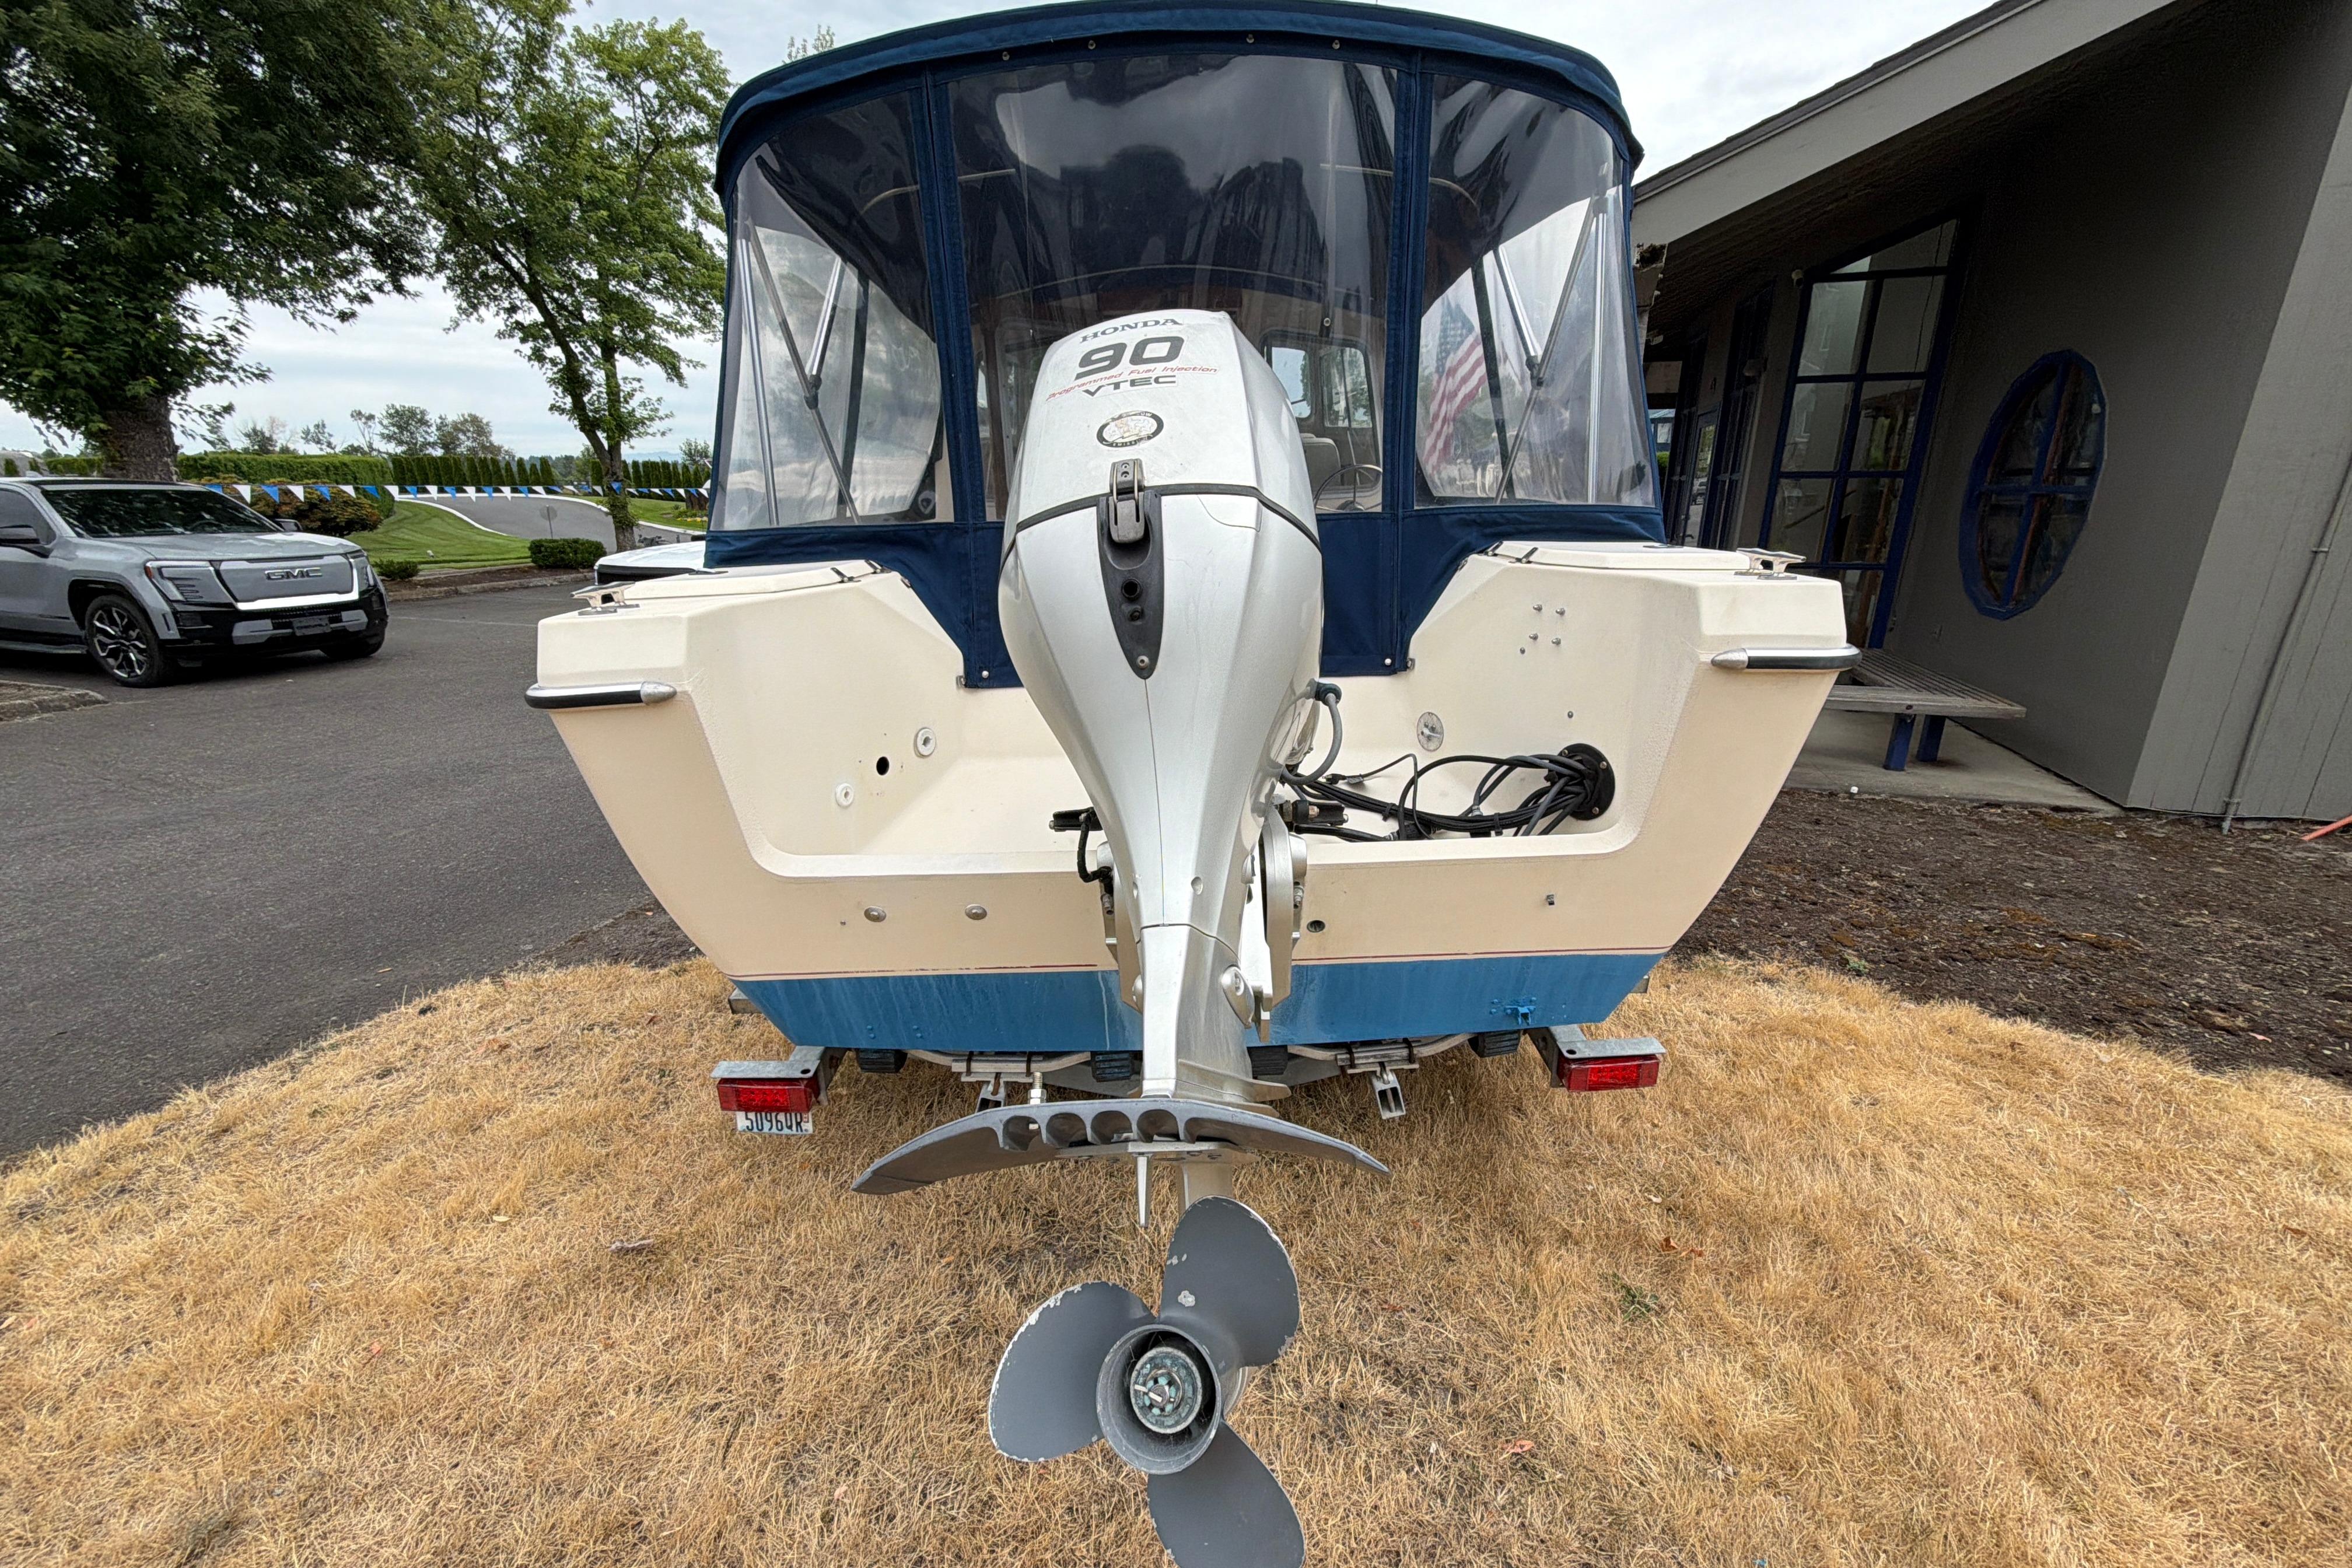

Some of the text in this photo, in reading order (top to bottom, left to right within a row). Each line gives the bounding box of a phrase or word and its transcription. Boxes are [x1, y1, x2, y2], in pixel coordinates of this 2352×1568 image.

[1080, 318, 1183, 343] HONDA
[1074, 336, 1184, 381] 90
[1046, 372, 1124, 401] Programmed
[1128, 367, 1157, 376] Fuel
[1082, 375, 1176, 397] VTEC
[265, 567, 322, 580] GMC
[745, 1112, 803, 1132] 5096QR
